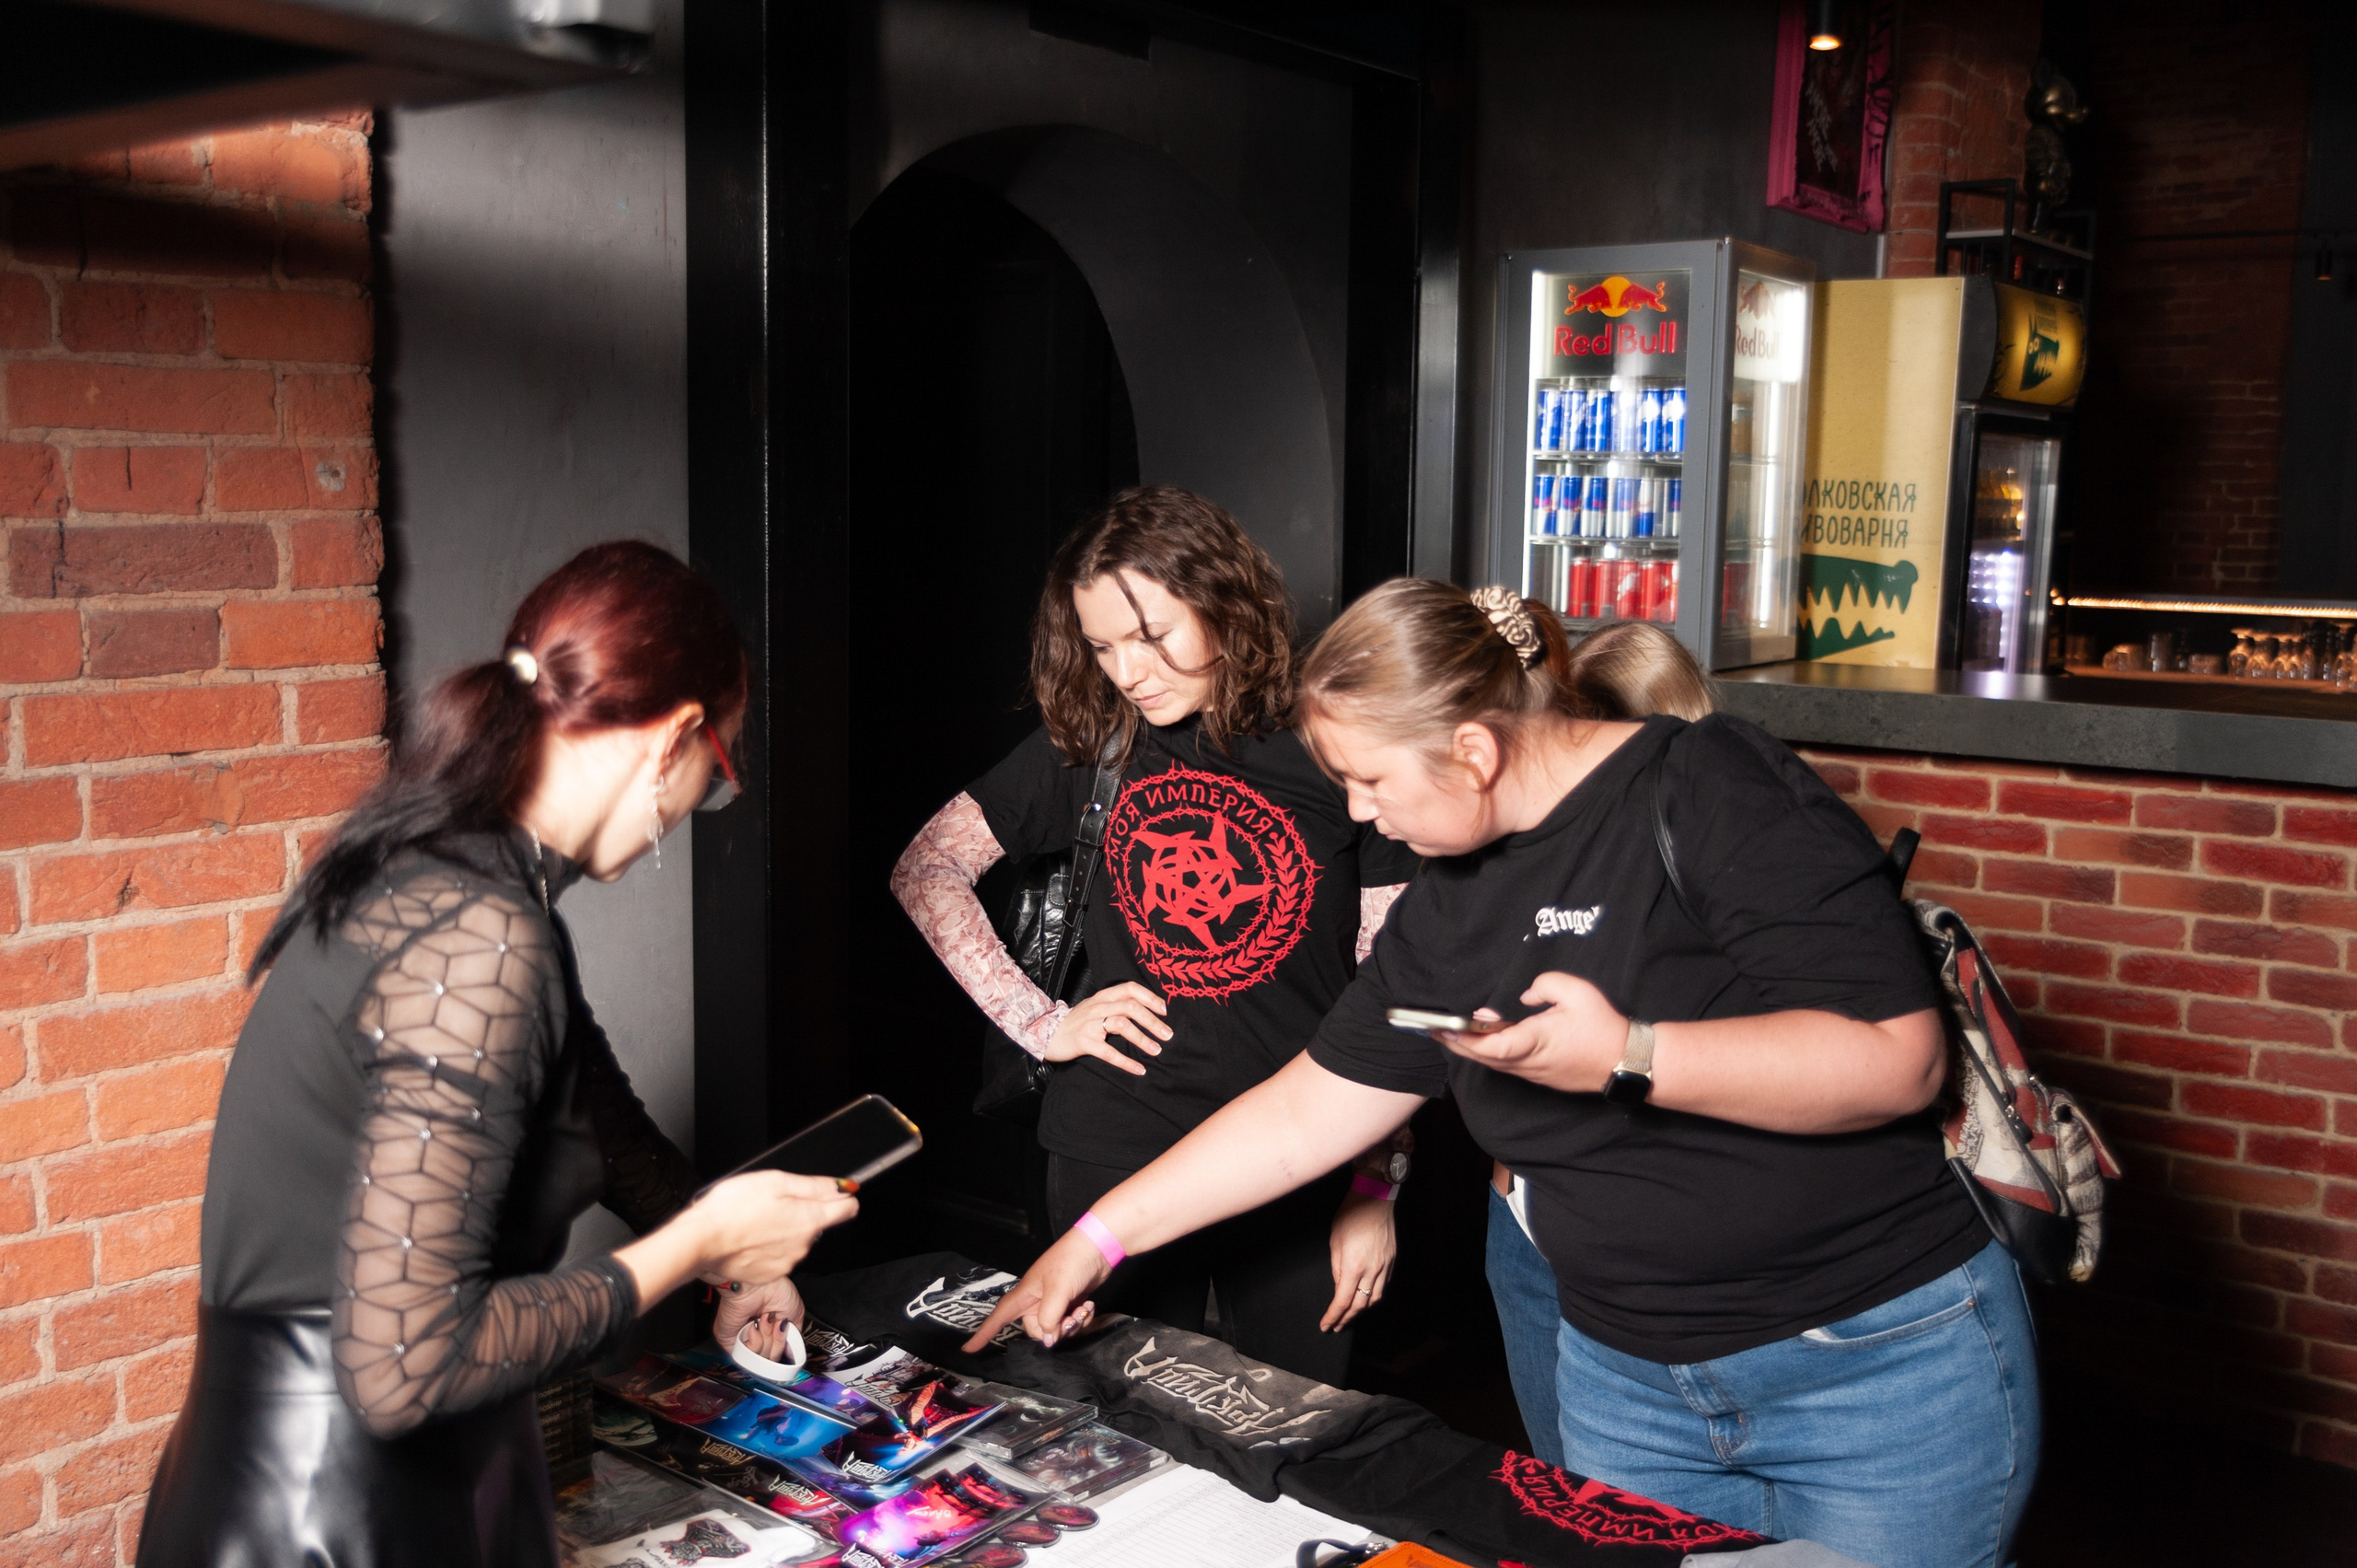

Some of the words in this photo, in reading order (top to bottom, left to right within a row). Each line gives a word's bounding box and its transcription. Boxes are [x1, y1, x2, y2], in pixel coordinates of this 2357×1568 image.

[1553, 323, 1612, 356] Red
[1617, 321, 1677, 355] Bull
[1735, 324, 1757, 357] Red
[1802, 479, 1917, 513] ЛКОВСКАЯ
[1800, 514, 1909, 549] ИВОВАРНЯ
[1110, 801, 1141, 860] МОЯ
[1145, 784, 1273, 834] ИМПЕРИЯ
[1522, 1475, 1655, 1540] ИМПЕРИЯ
